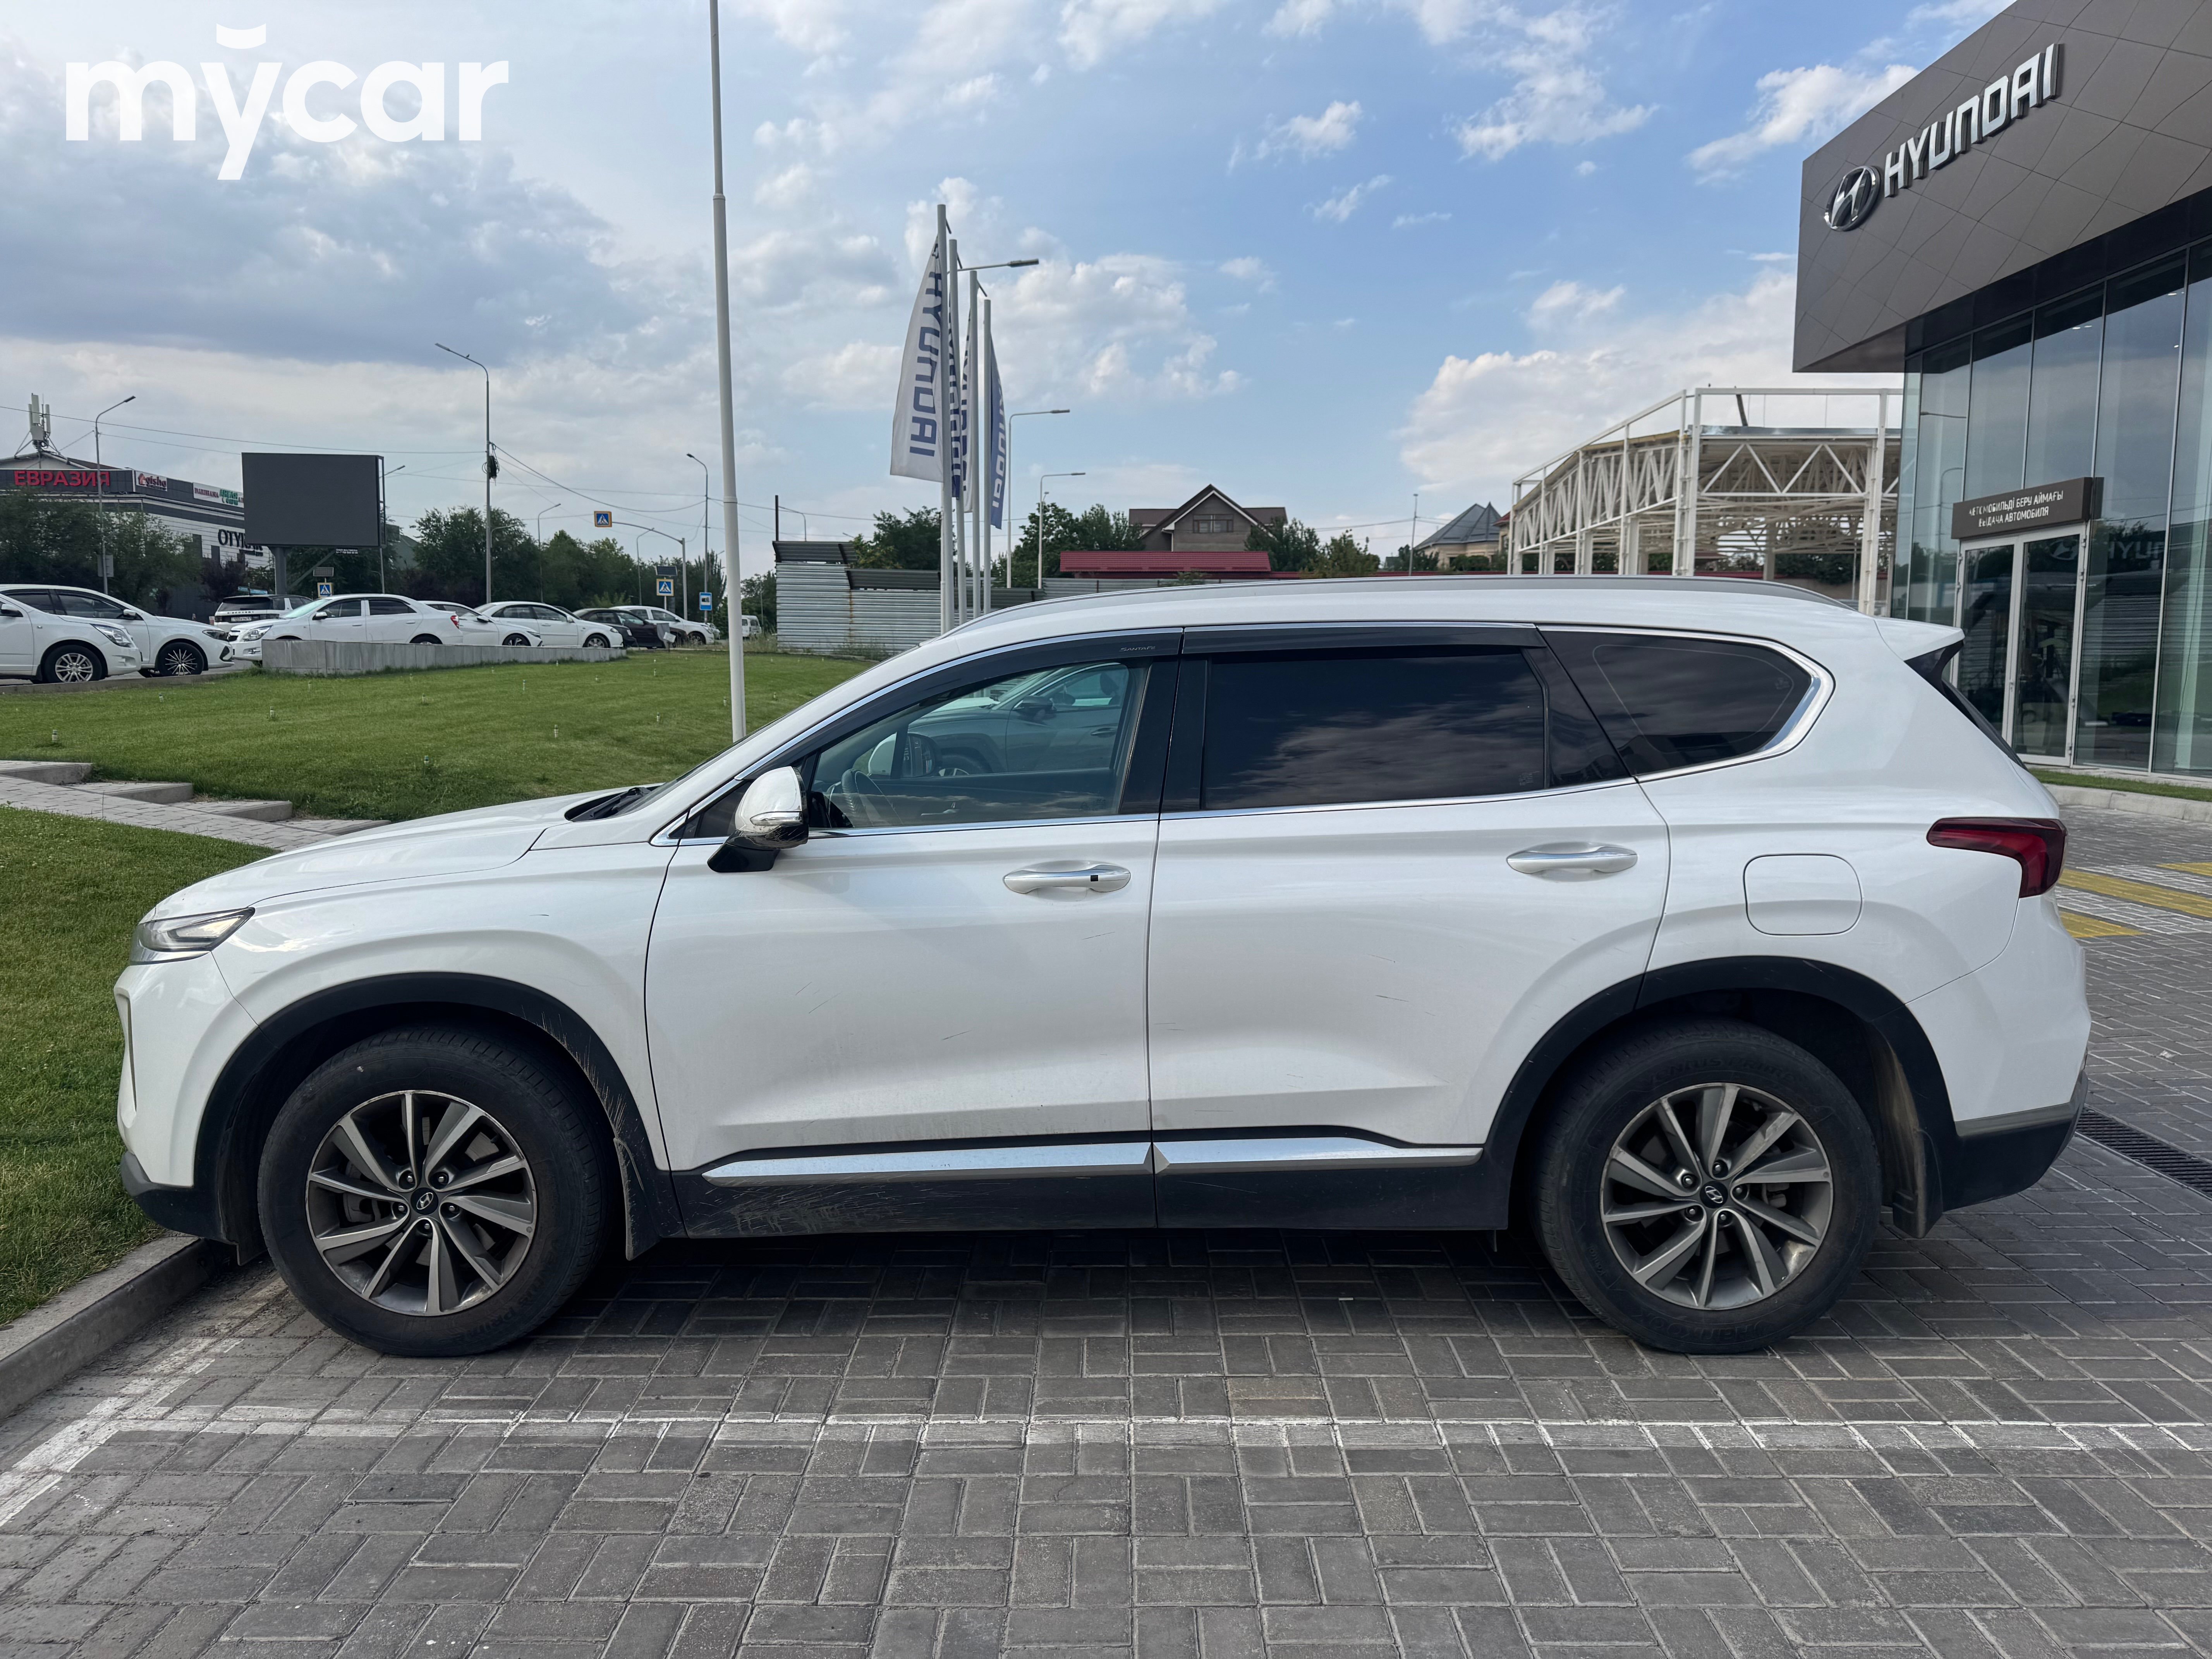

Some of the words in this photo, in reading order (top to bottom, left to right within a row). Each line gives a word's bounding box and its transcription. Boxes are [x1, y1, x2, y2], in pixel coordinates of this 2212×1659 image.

[1884, 43, 2060, 198] HYUNDAI
[909, 271, 942, 457] HYUNDAI
[14, 471, 110, 486] ЕВРАЗИЯ
[2016, 496, 2032, 508] БЕРУ
[2004, 506, 2049, 522] АВТОМОБИЛЯ
